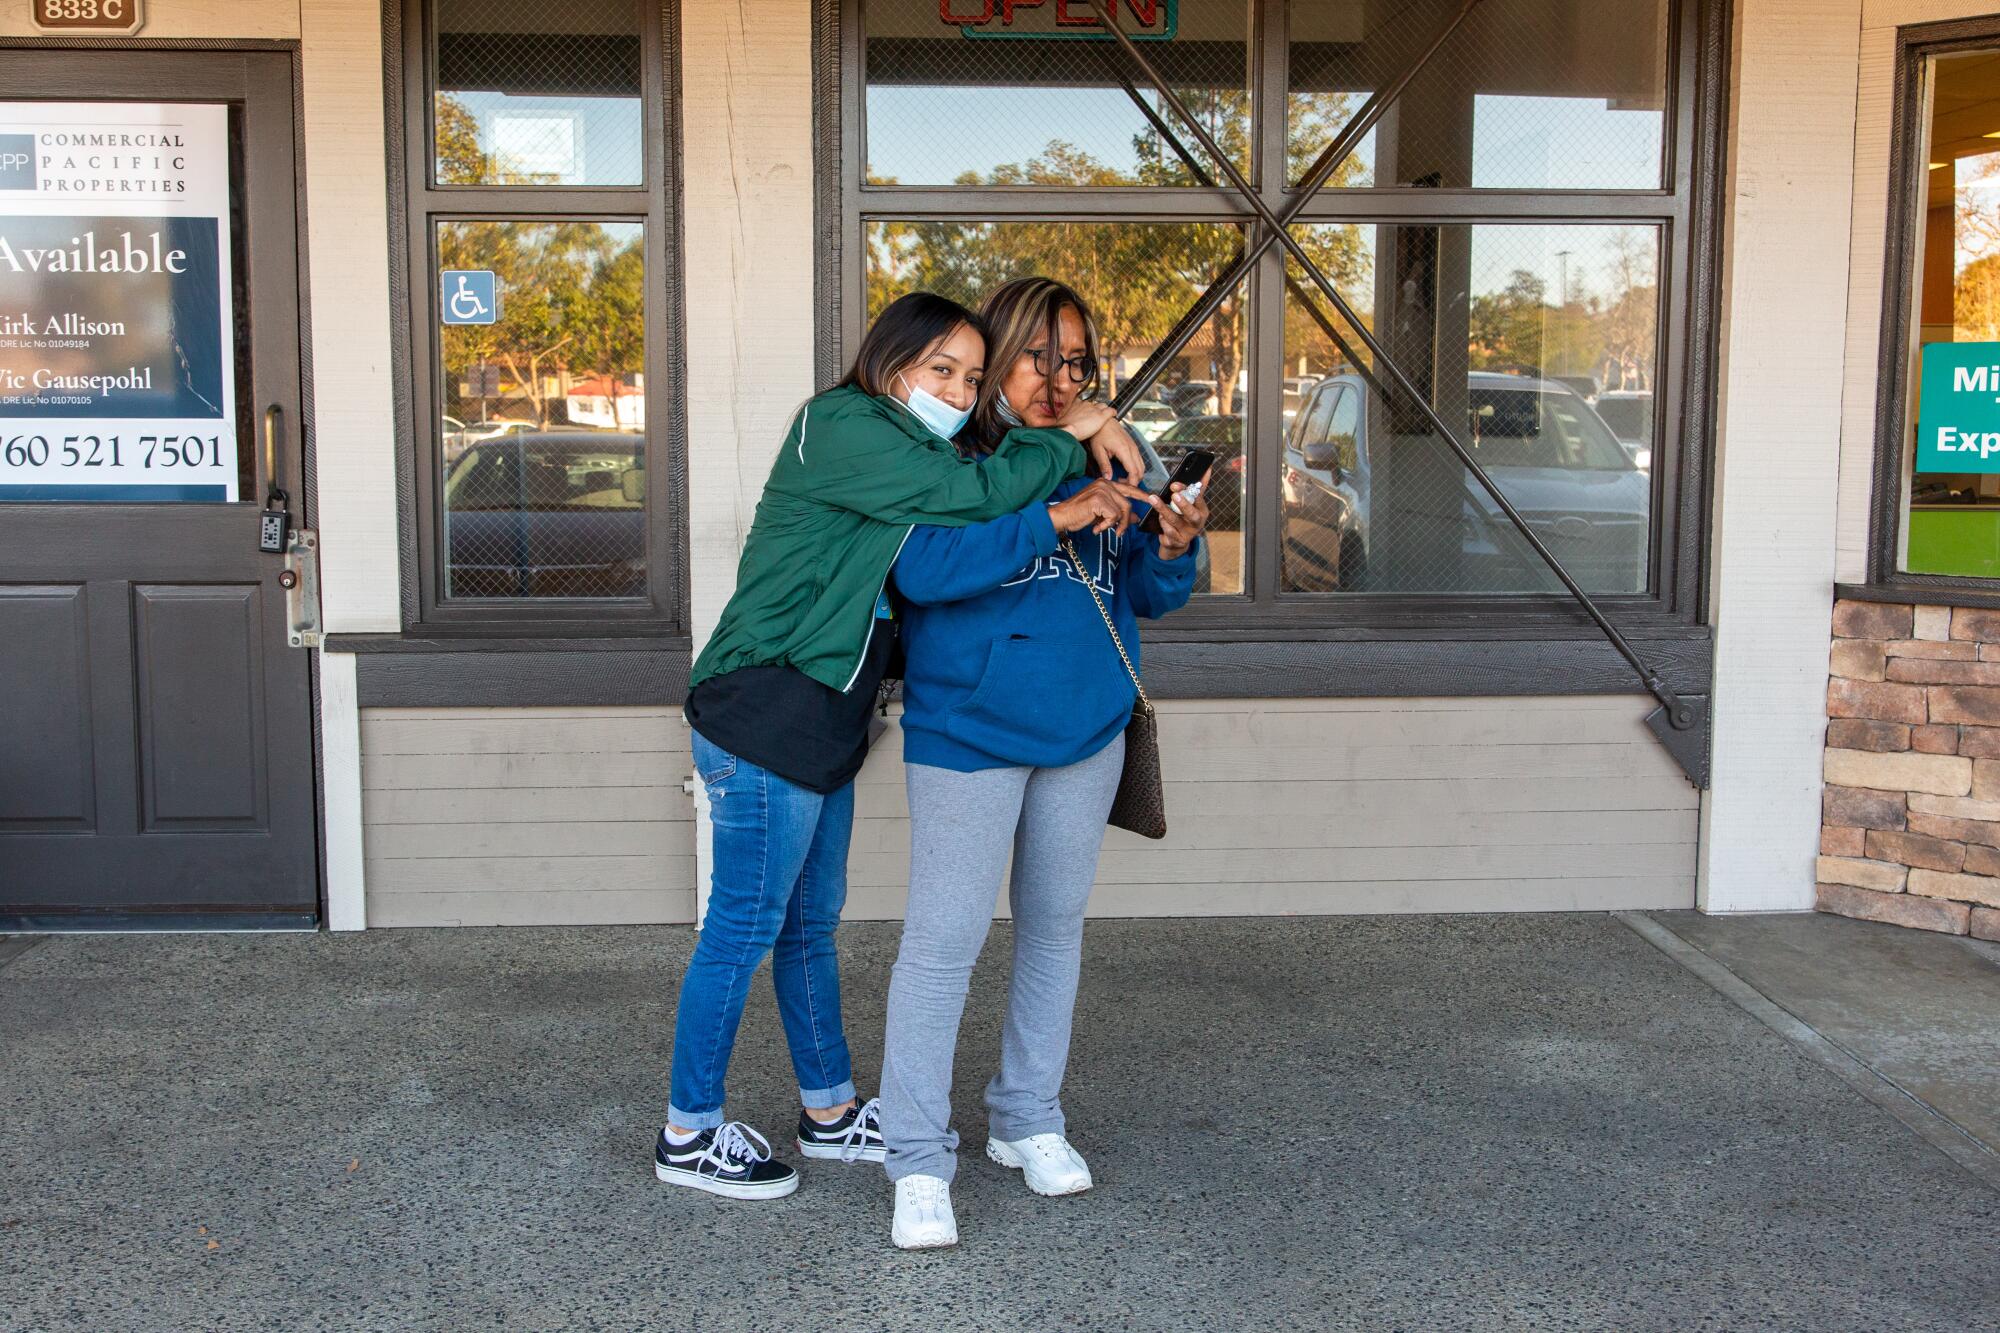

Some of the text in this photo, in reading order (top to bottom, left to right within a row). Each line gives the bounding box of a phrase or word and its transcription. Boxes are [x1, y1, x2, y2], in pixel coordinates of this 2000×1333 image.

[41, 134, 184, 147] COMMERCIAL
[0, 153, 29, 171] PP
[41, 156, 185, 169] PACIFIC
[43, 179, 185, 192] PROPERTIES
[45, 312, 126, 336] Allison
[20, 340, 32, 348] Lic
[34, 340, 47, 348] No
[48, 340, 90, 348] 01049184
[32, 367, 152, 397] Gausepohl
[1953, 365, 2000, 404] Mi
[37, 396, 49, 404] No
[51, 396, 92, 404] 01070105
[0, 435, 225, 469] 60 521 7501
